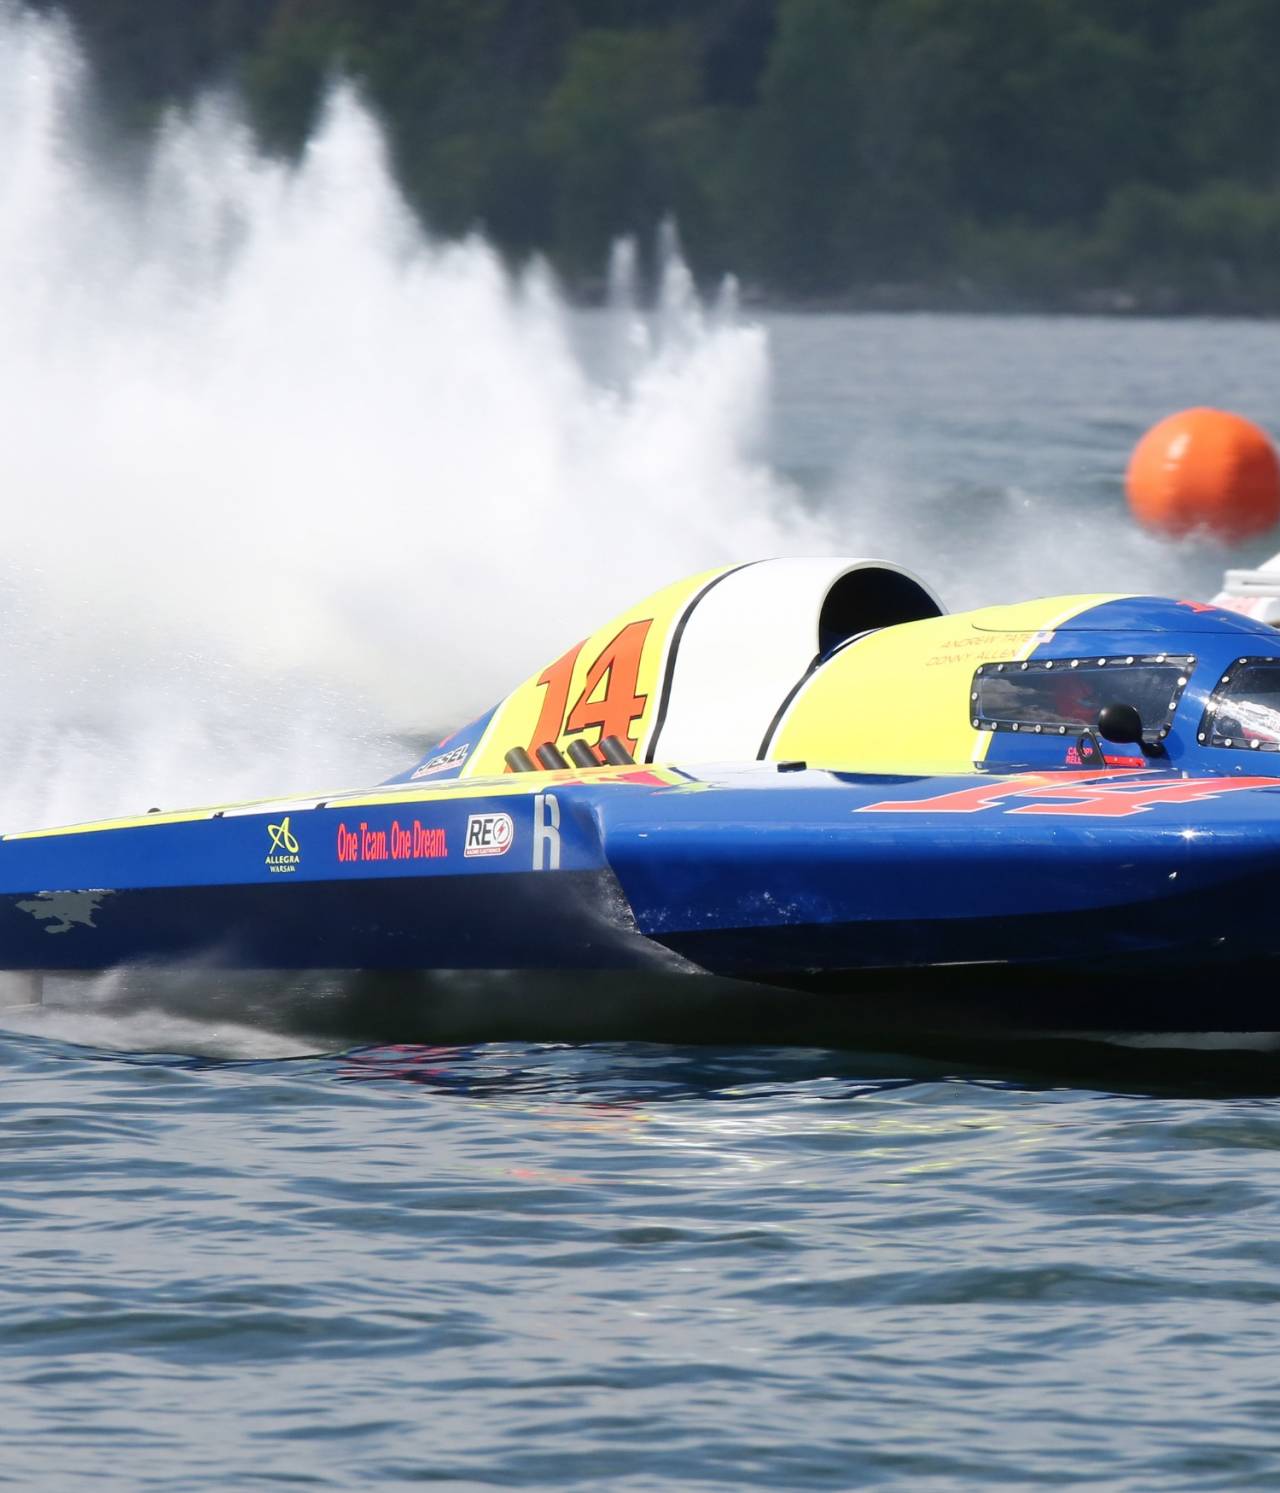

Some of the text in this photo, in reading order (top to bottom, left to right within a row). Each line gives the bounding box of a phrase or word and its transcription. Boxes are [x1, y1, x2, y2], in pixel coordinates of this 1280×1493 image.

[503, 618, 654, 773] 14
[265, 855, 300, 864] ALLEGRA
[337, 819, 448, 862] One Team. One Dream.
[532, 793, 560, 870] R
